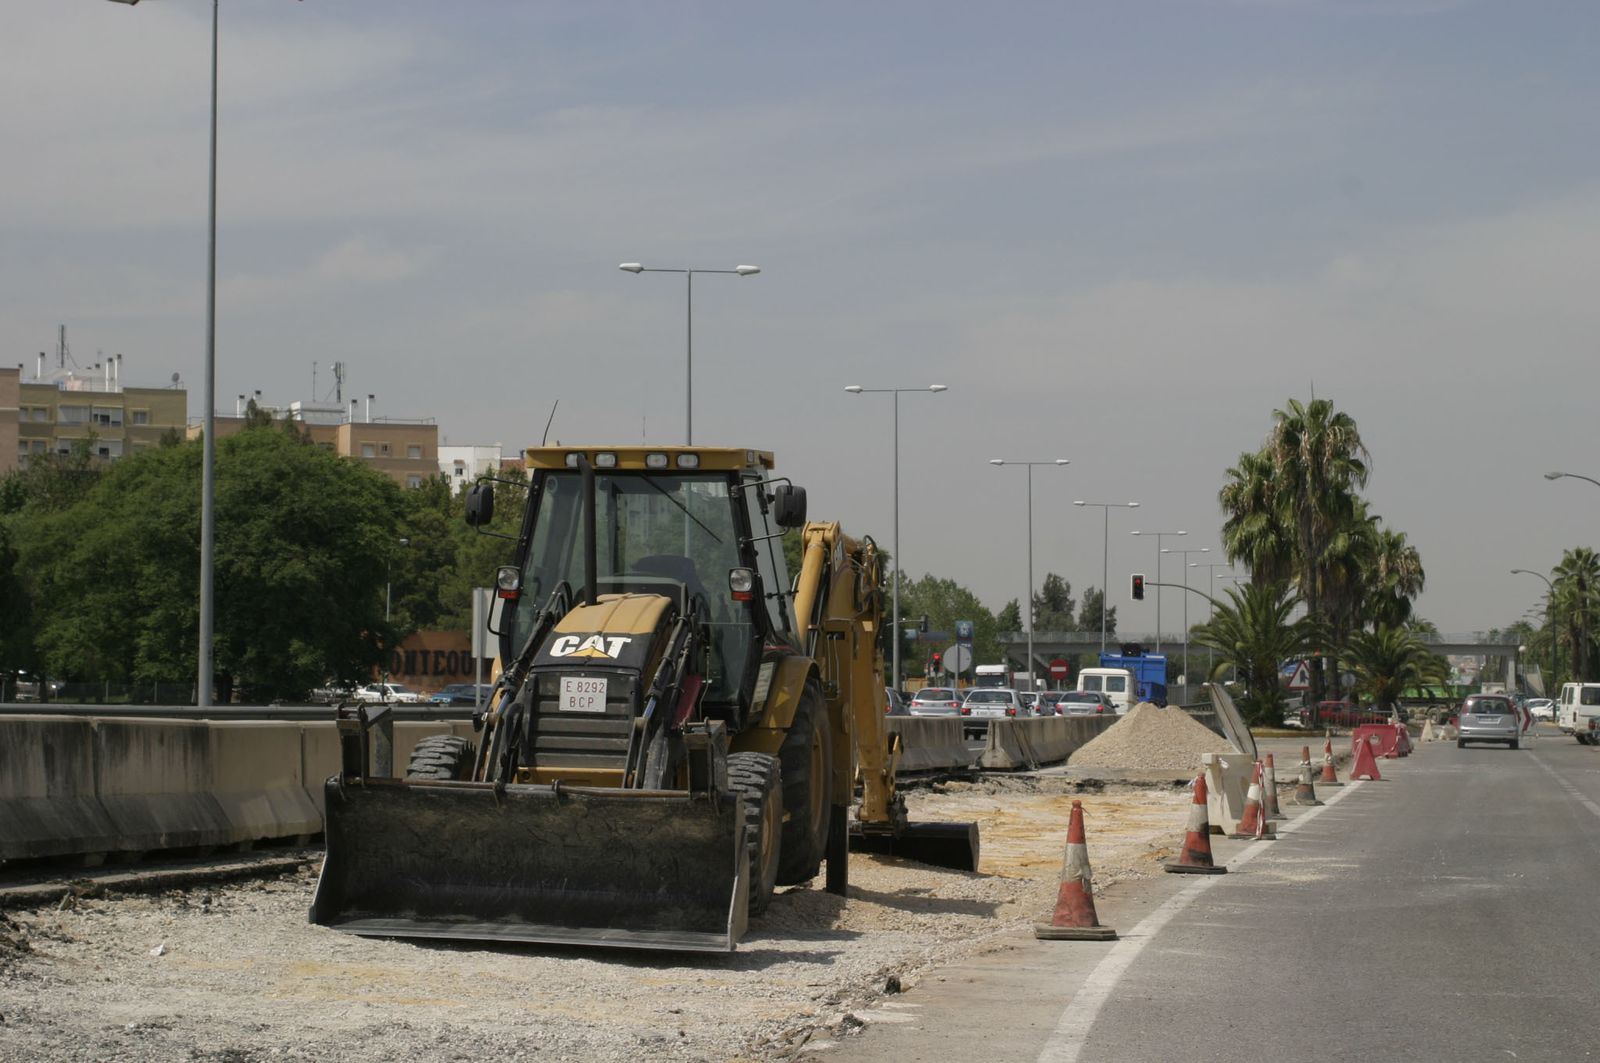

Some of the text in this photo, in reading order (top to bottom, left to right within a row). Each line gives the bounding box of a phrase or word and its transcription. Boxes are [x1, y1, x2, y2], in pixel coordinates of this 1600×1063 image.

[549, 634, 632, 659] CAT
[565, 680, 605, 693] E 8292
[569, 696, 595, 708] BCP
